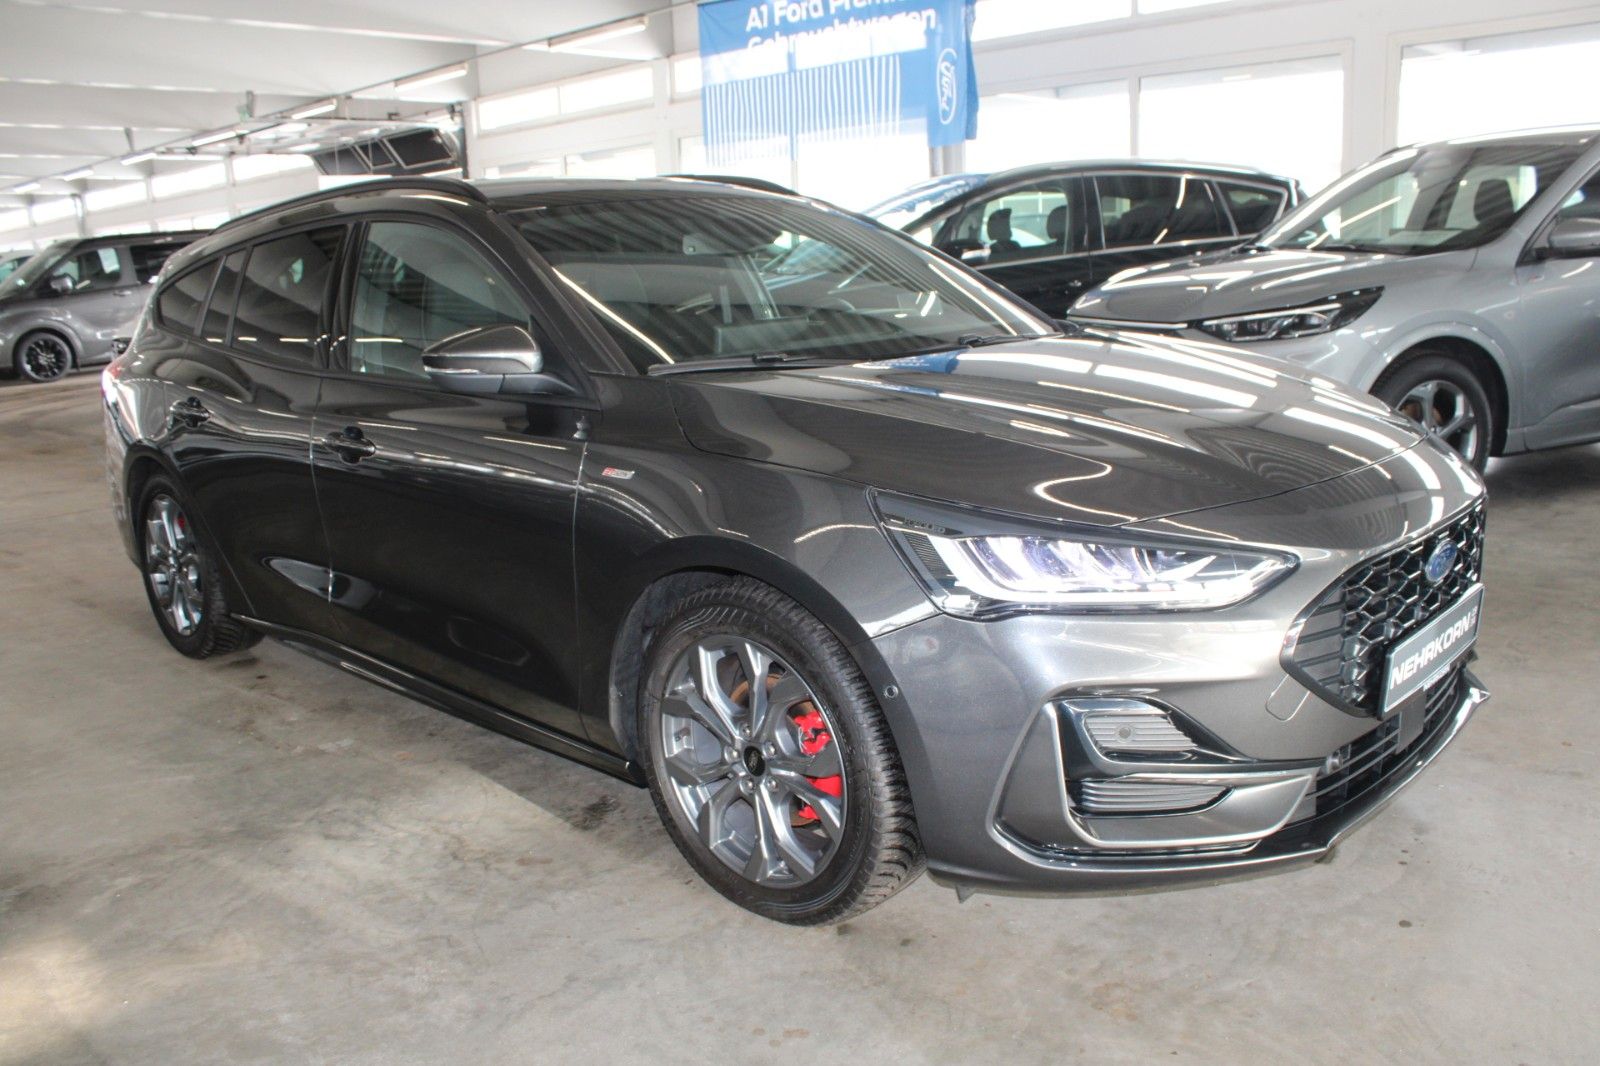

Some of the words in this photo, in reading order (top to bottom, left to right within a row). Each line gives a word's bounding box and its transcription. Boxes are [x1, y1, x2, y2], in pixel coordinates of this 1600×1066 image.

[746, 3, 768, 32] A1
[774, 0, 824, 26] Ford
[1390, 612, 1470, 689] NEHRKORN
